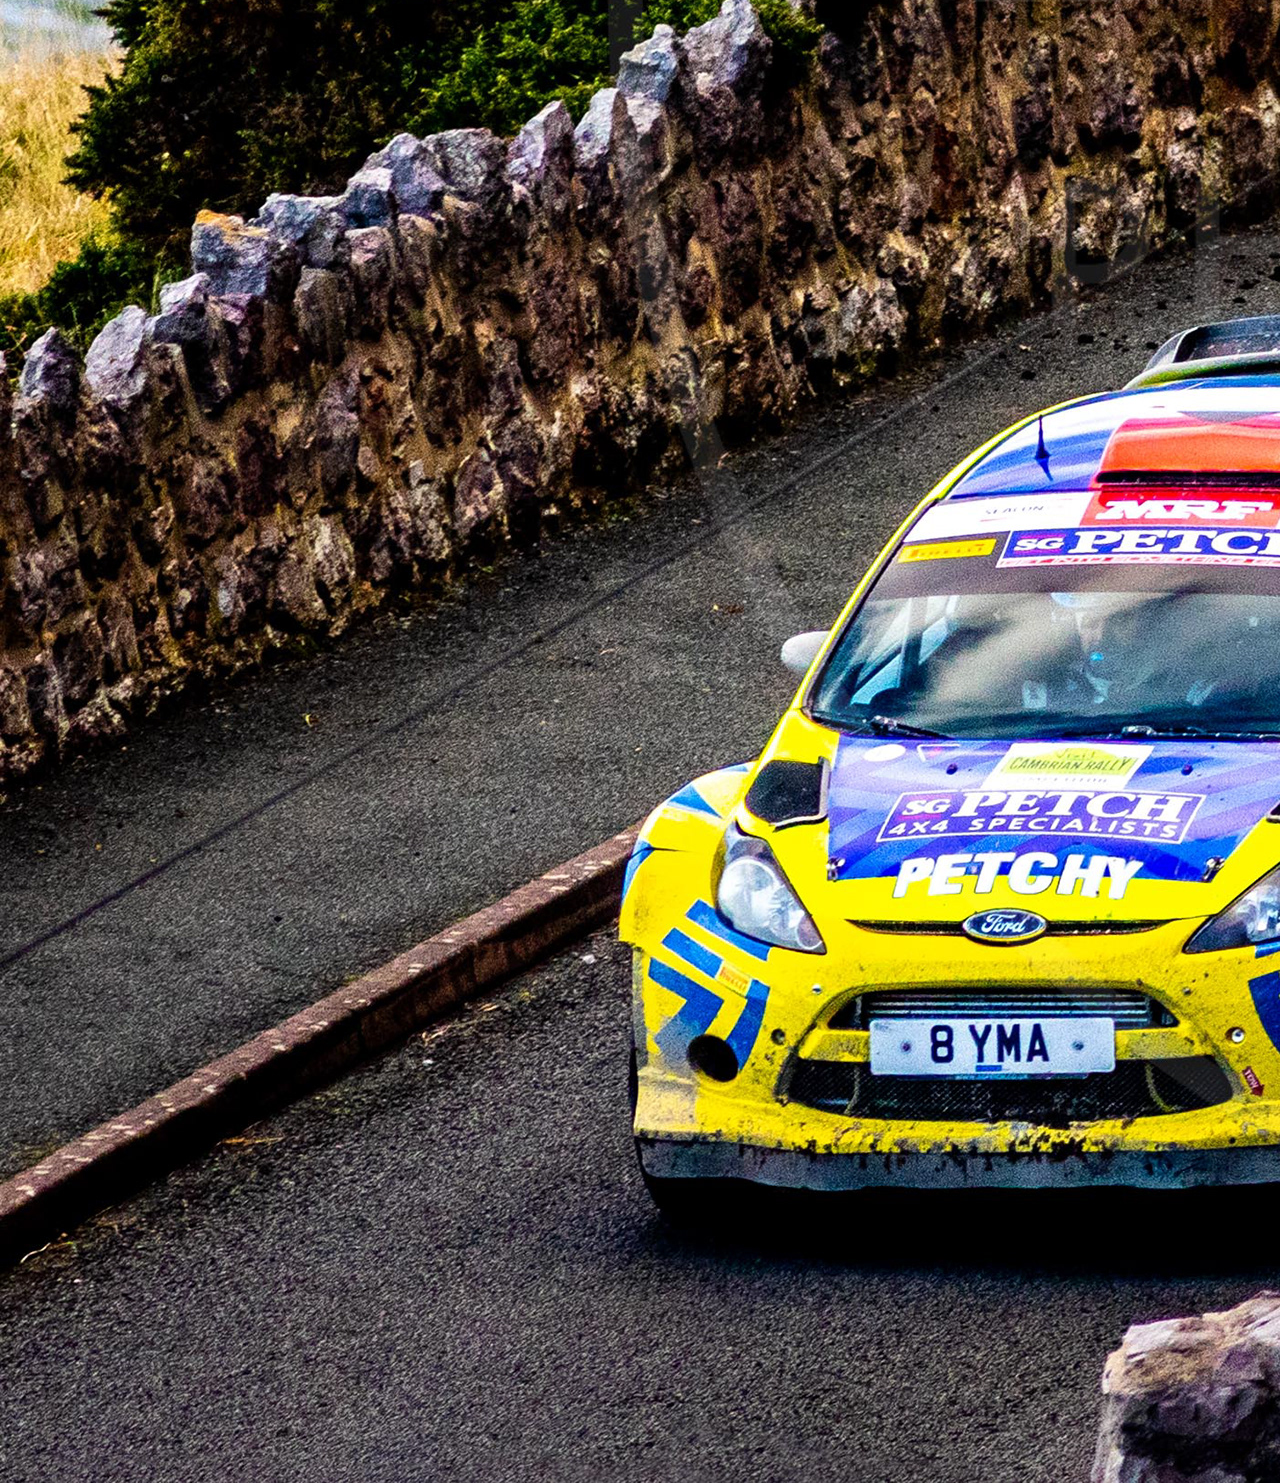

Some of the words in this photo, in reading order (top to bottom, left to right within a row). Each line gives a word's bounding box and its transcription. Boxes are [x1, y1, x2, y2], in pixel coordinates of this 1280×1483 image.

[1095, 500, 1273, 520] MRF
[1013, 537, 1064, 552] SG
[1010, 757, 1084, 771] CAMBRIAN
[1085, 757, 1132, 771] RALLY
[901, 799, 949, 816] SG
[952, 791, 1193, 824] PETCH
[888, 819, 948, 836] 4X4
[970, 817, 1178, 838] SPECIALISTS
[891, 851, 1144, 900] PETCHY
[981, 911, 1026, 934] Ford
[930, 1024, 954, 1063] 8
[969, 1023, 1050, 1063] YMA
[1243, 1068, 1260, 1089] TOW
